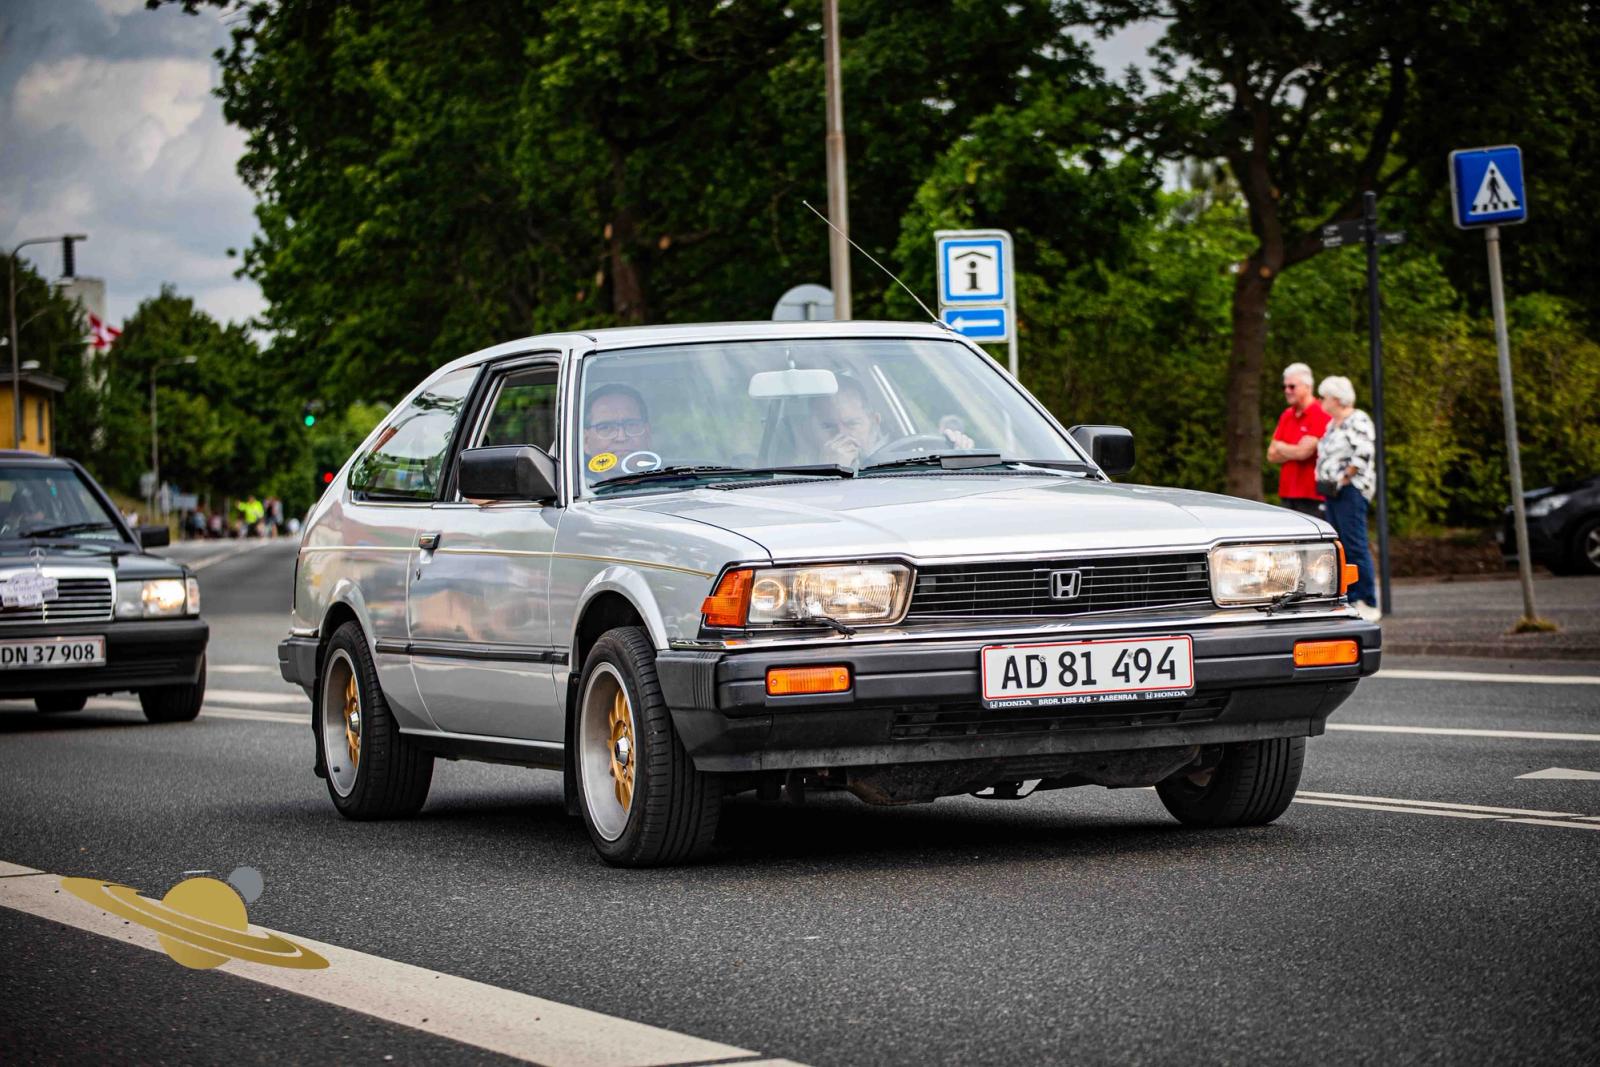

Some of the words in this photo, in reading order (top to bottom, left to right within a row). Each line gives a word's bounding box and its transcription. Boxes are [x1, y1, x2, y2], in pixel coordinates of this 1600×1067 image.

[1, 647, 28, 664] DN
[33, 645, 56, 663] 37
[61, 643, 95, 662] 908
[1001, 654, 1048, 690] AD
[1058, 650, 1097, 687] 81
[1112, 646, 1177, 684] 494
[1099, 693, 1138, 702] AABENRAA
[1153, 690, 1188, 698] HONDA
